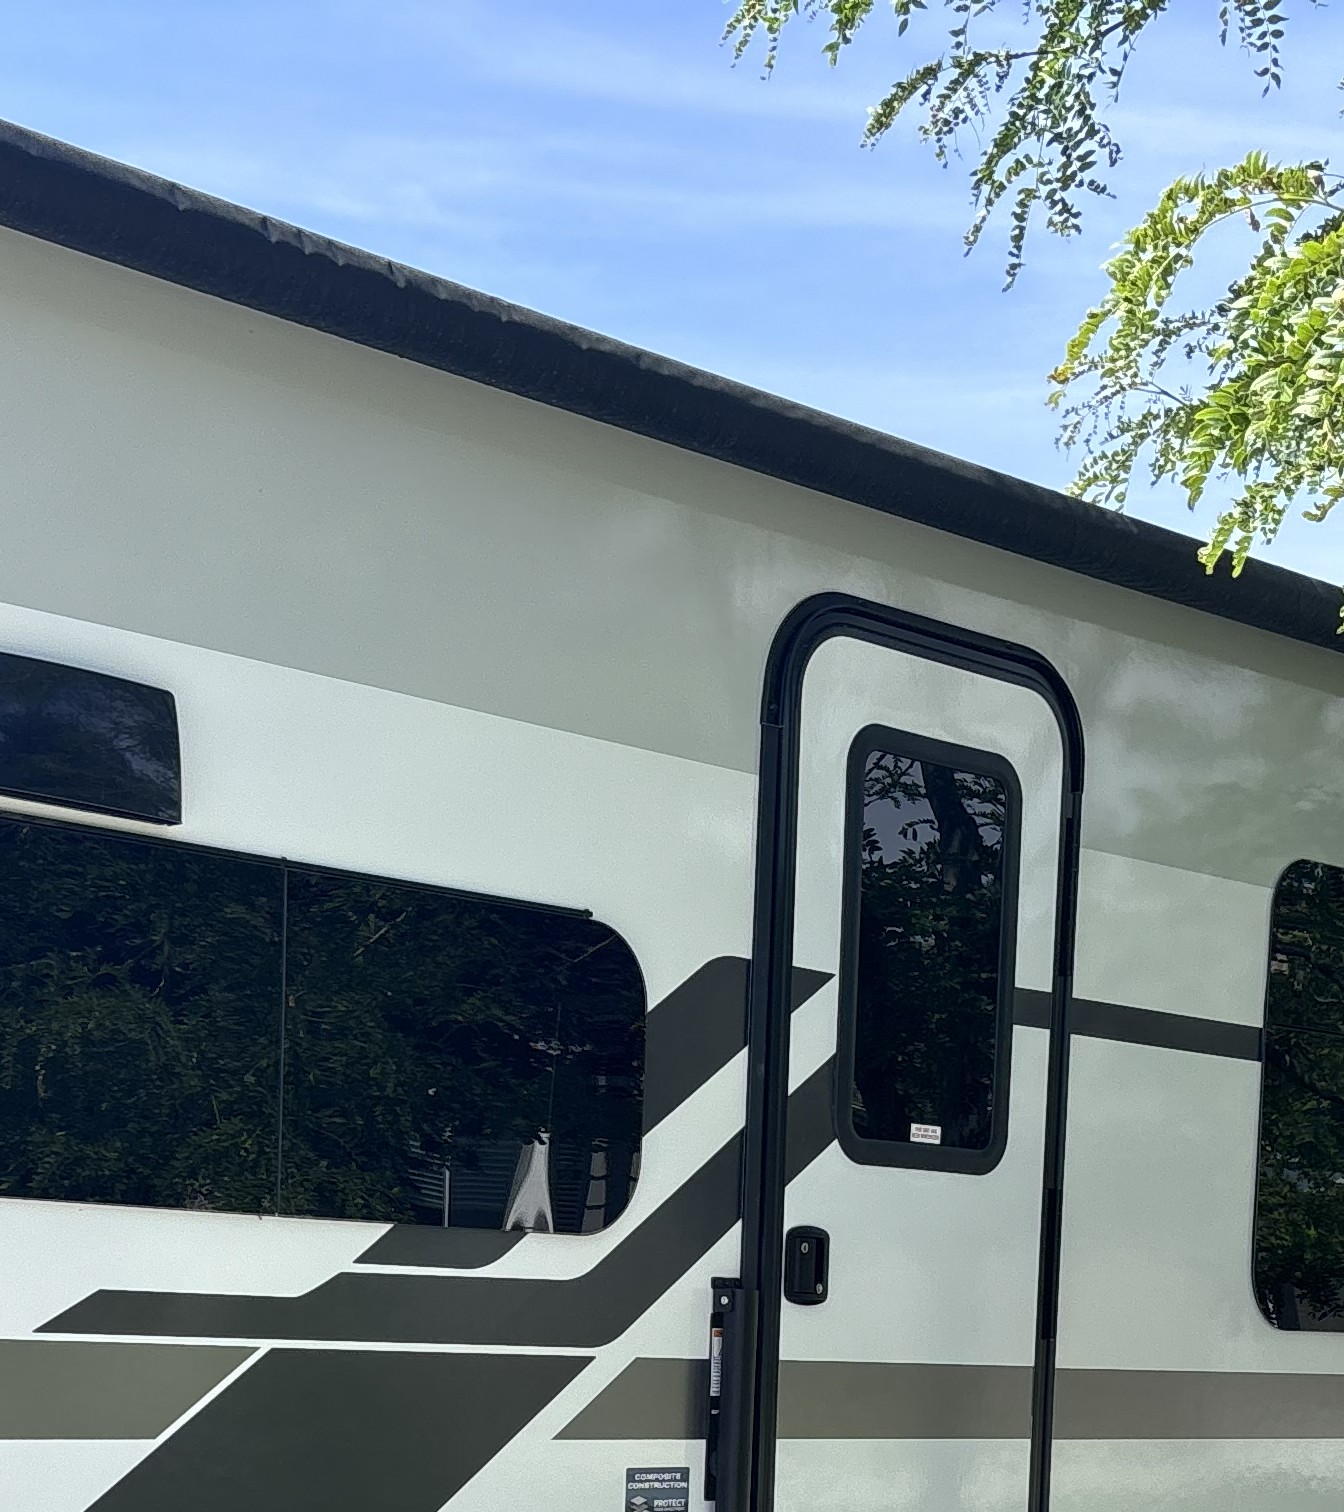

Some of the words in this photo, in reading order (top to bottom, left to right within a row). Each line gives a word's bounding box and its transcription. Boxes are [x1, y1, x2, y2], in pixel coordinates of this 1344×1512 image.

[634, 1472, 682, 1481] COMPOSITE
[627, 1481, 688, 1490] CONSTRUCTION
[653, 1498, 686, 1508] PROTECT
